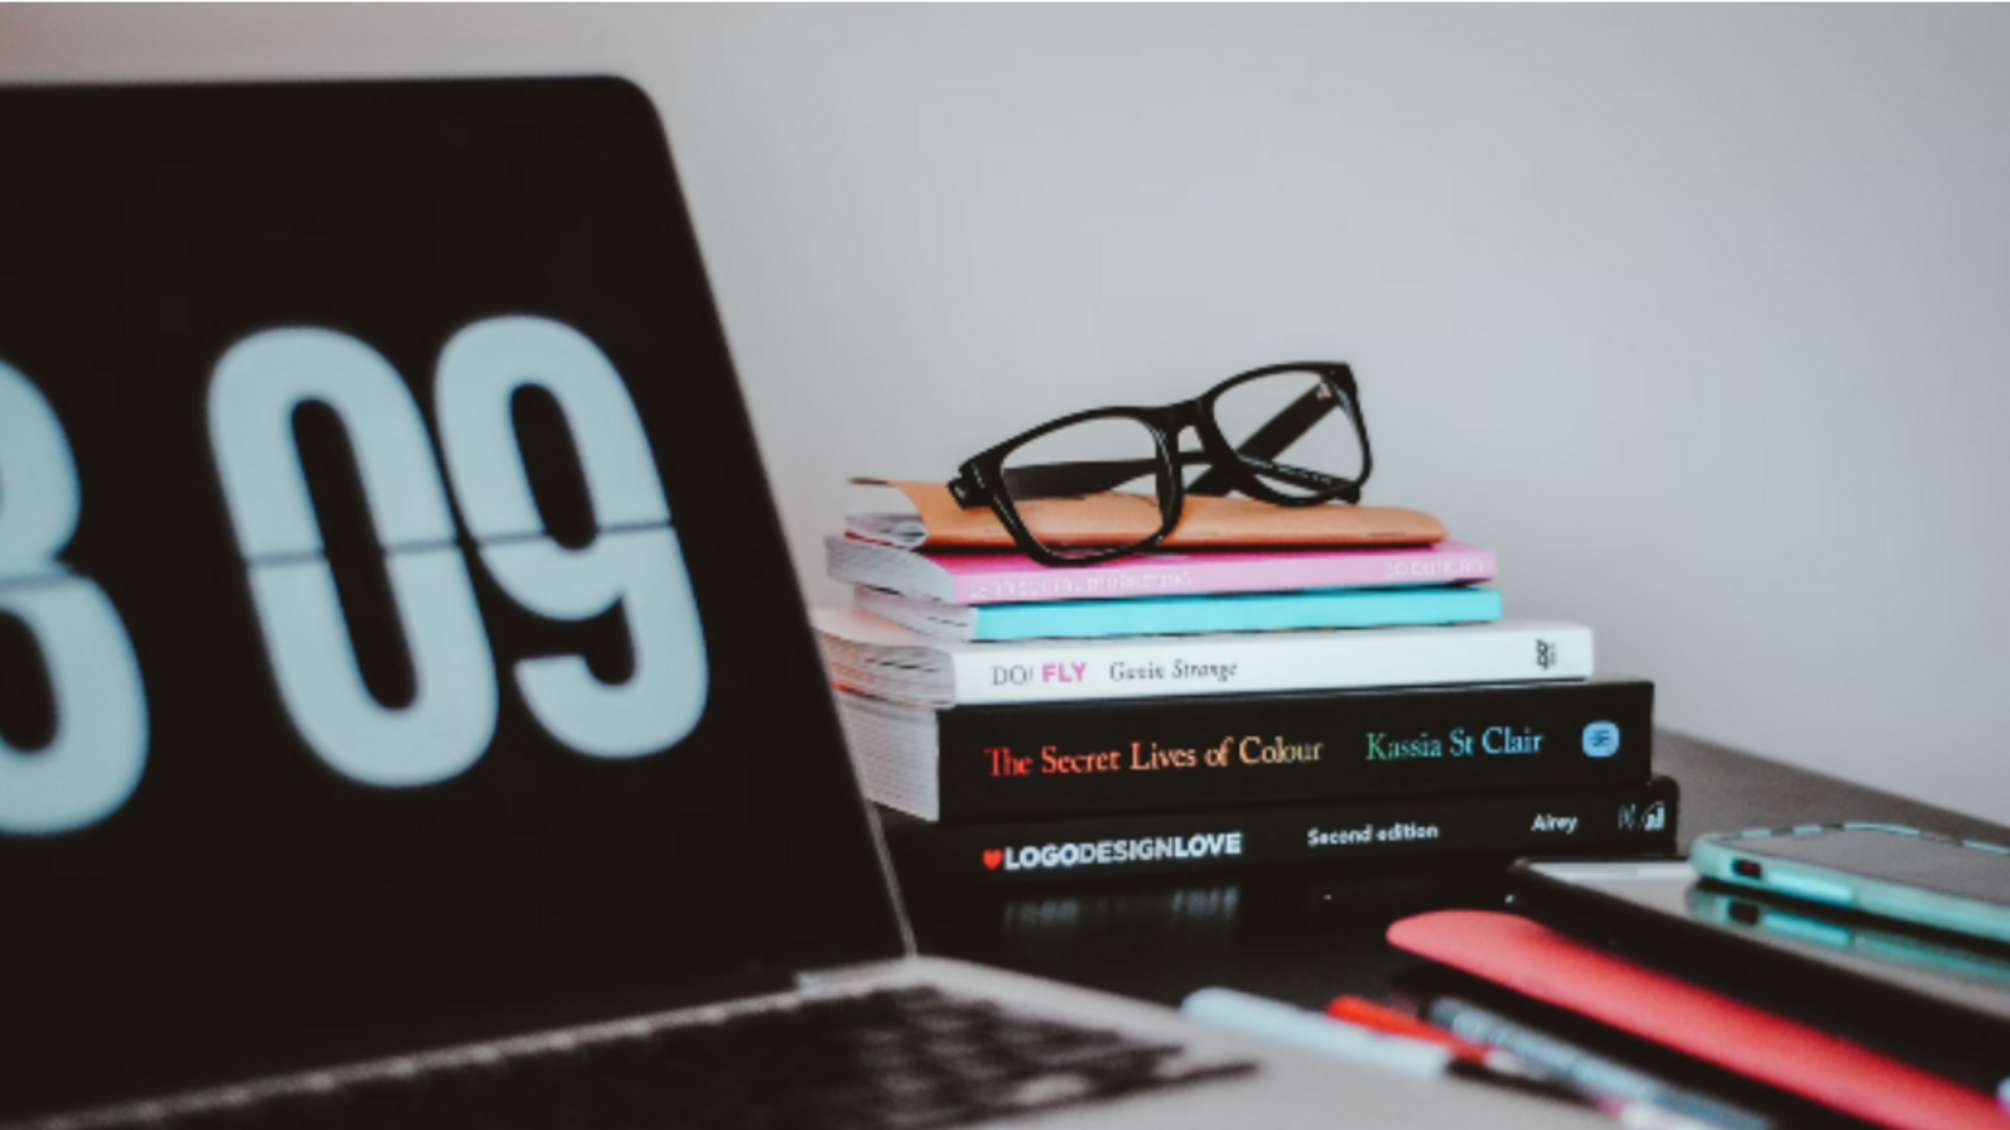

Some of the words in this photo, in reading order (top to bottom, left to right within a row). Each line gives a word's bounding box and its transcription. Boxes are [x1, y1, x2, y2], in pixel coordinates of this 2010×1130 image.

[207, 313, 709, 787] 09
[1041, 661, 1088, 683] FLY
[1171, 658, 1238, 683] Strange
[984, 746, 1033, 777] The
[1040, 745, 1121, 774] Secret
[1129, 741, 1198, 771] Lives
[1203, 735, 1234, 767] of
[1238, 735, 1324, 765] Colour
[1366, 732, 1443, 761] Kassia
[1449, 727, 1475, 758] St
[1481, 726, 1544, 755] Clair
[1306, 821, 1373, 846] Second
[1376, 821, 1440, 843] edition
[1530, 813, 1579, 835] Airey
